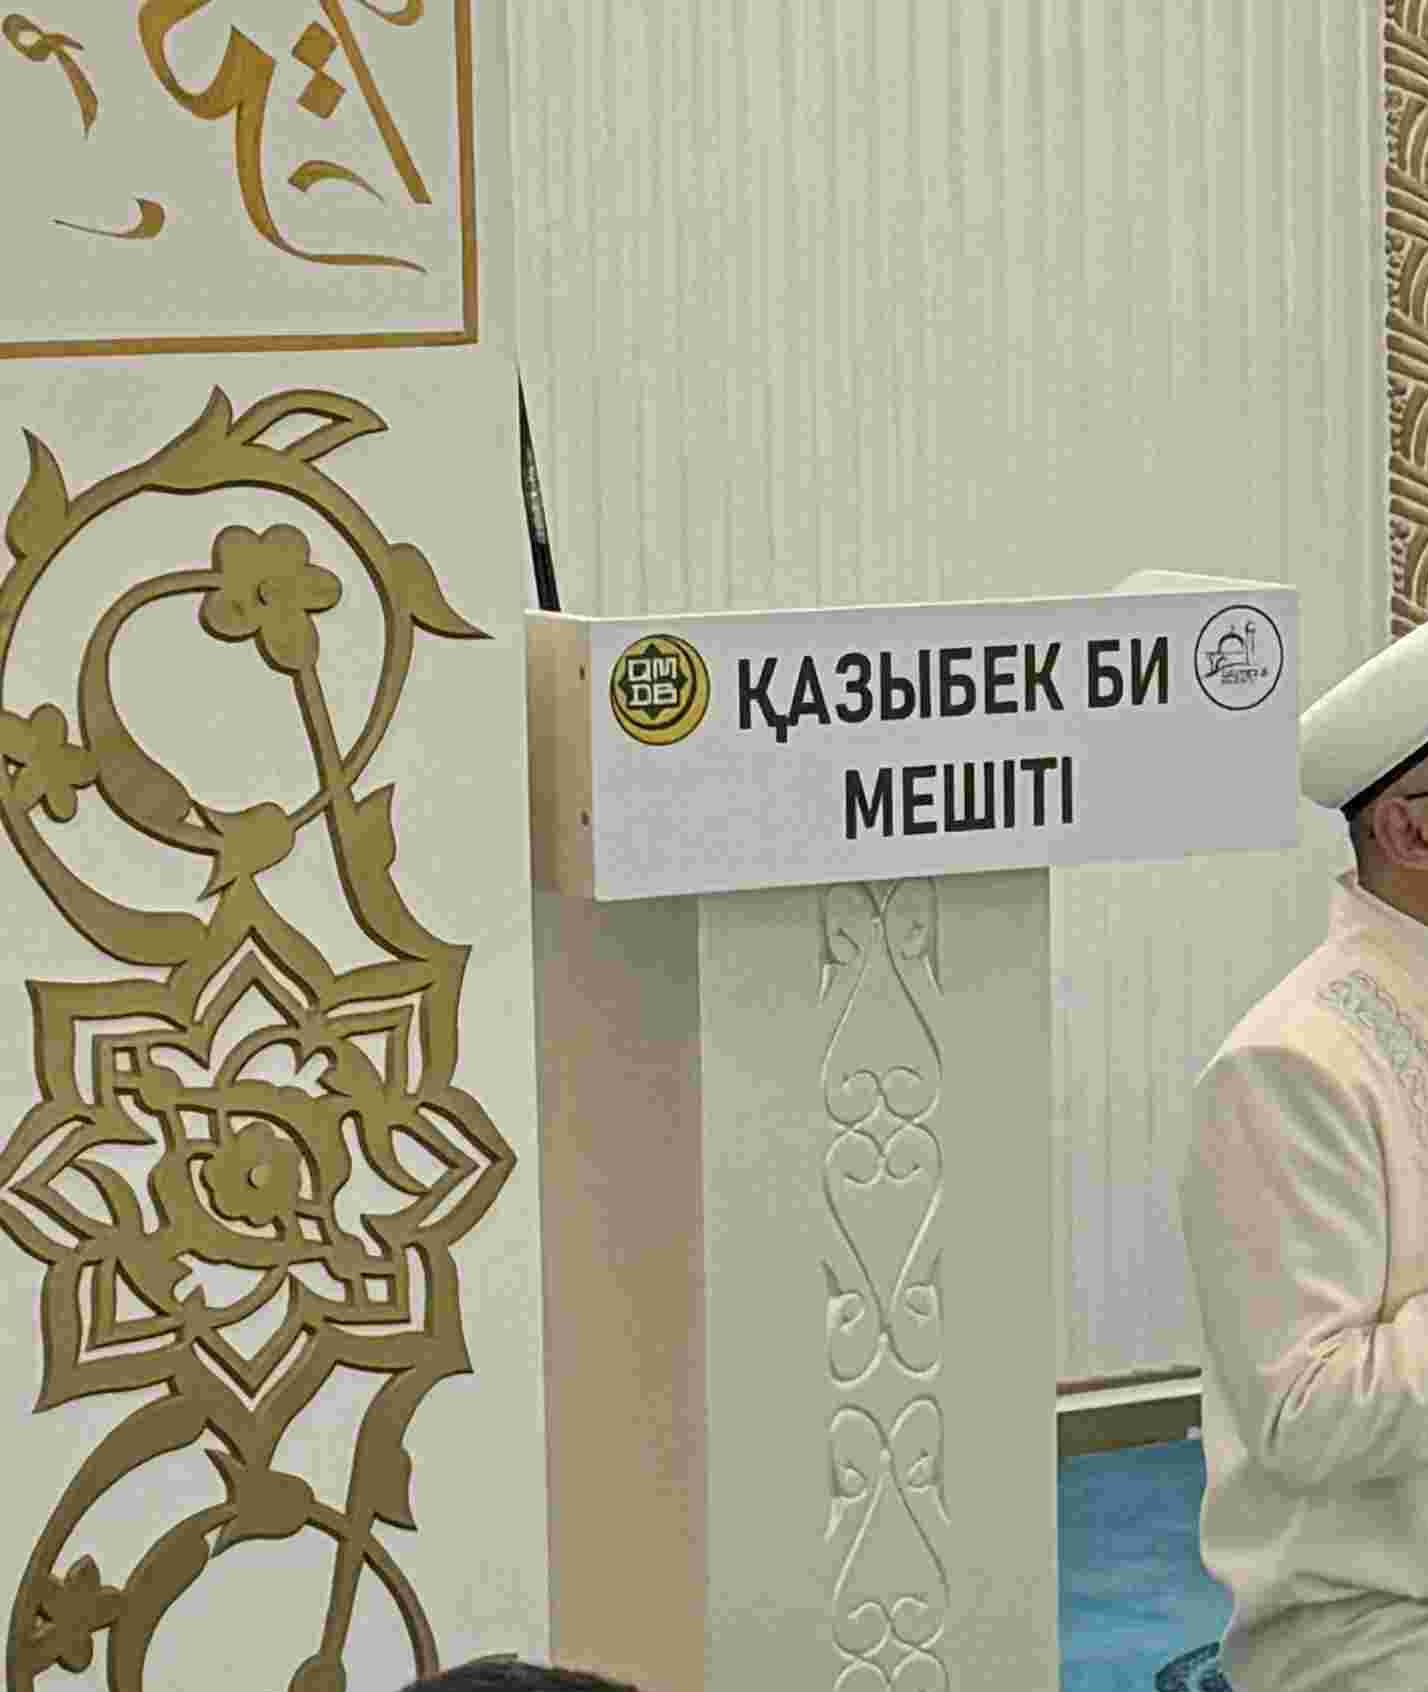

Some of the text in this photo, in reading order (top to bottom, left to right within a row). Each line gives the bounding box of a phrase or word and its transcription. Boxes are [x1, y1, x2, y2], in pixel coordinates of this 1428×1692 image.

[738, 636, 1169, 744] ҚАЗЫБЕК БИ
[845, 756, 1073, 840] МЕШІТІ
